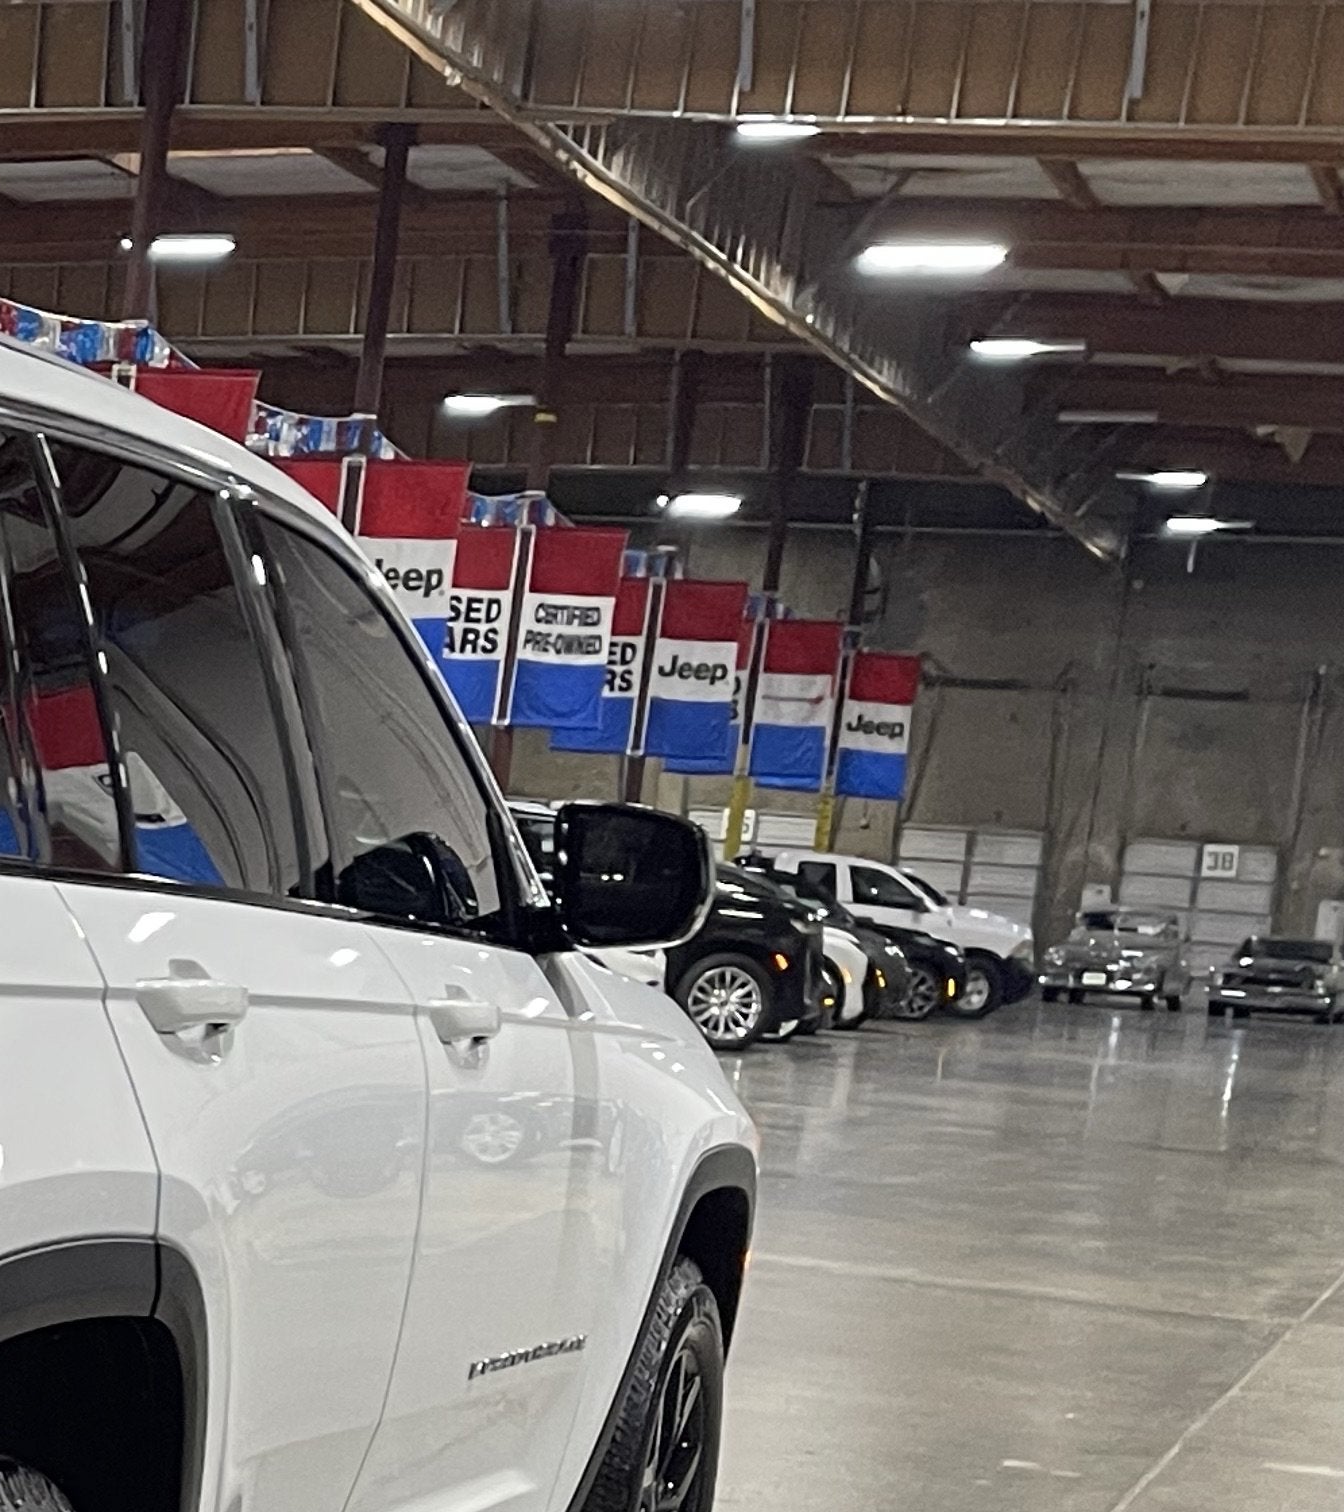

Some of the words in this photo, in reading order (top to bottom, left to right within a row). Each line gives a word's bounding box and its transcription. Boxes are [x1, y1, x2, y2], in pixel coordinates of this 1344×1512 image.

[448, 594, 502, 624] SED
[444, 627, 499, 654] ARS
[608, 641, 637, 667] ED
[658, 654, 728, 686] Jeep
[846, 713, 905, 740] Jeep
